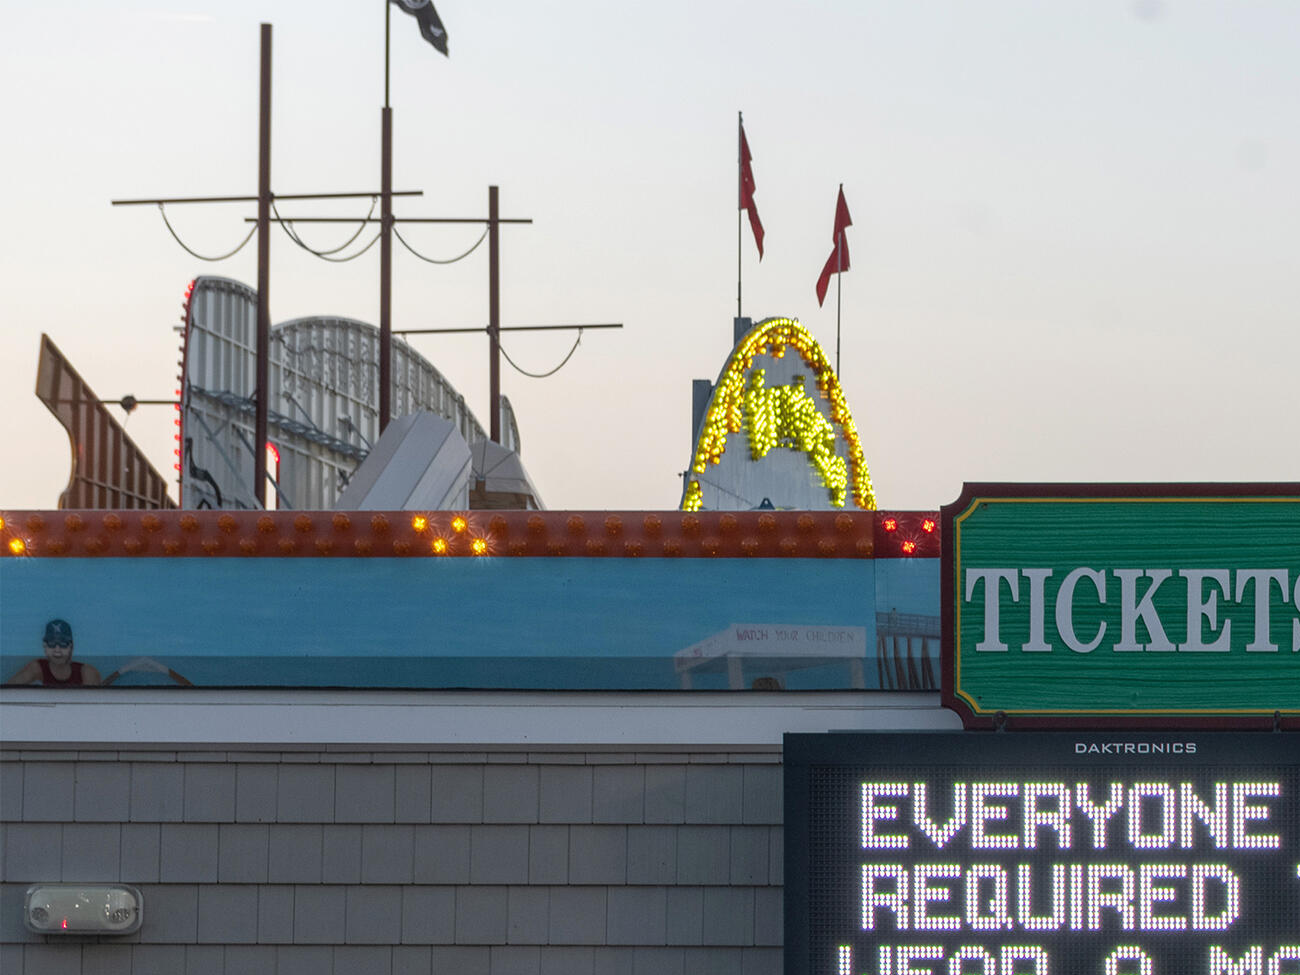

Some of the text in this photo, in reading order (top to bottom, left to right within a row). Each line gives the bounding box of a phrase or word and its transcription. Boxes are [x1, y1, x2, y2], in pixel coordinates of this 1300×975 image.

[736, 629, 855, 643] WATCH YOUR CHILDREN
[1074, 742, 1198, 755] DAKTRONICS
[860, 782, 1281, 849] EVERYONE
[860, 864, 1241, 930] REQUIRED
